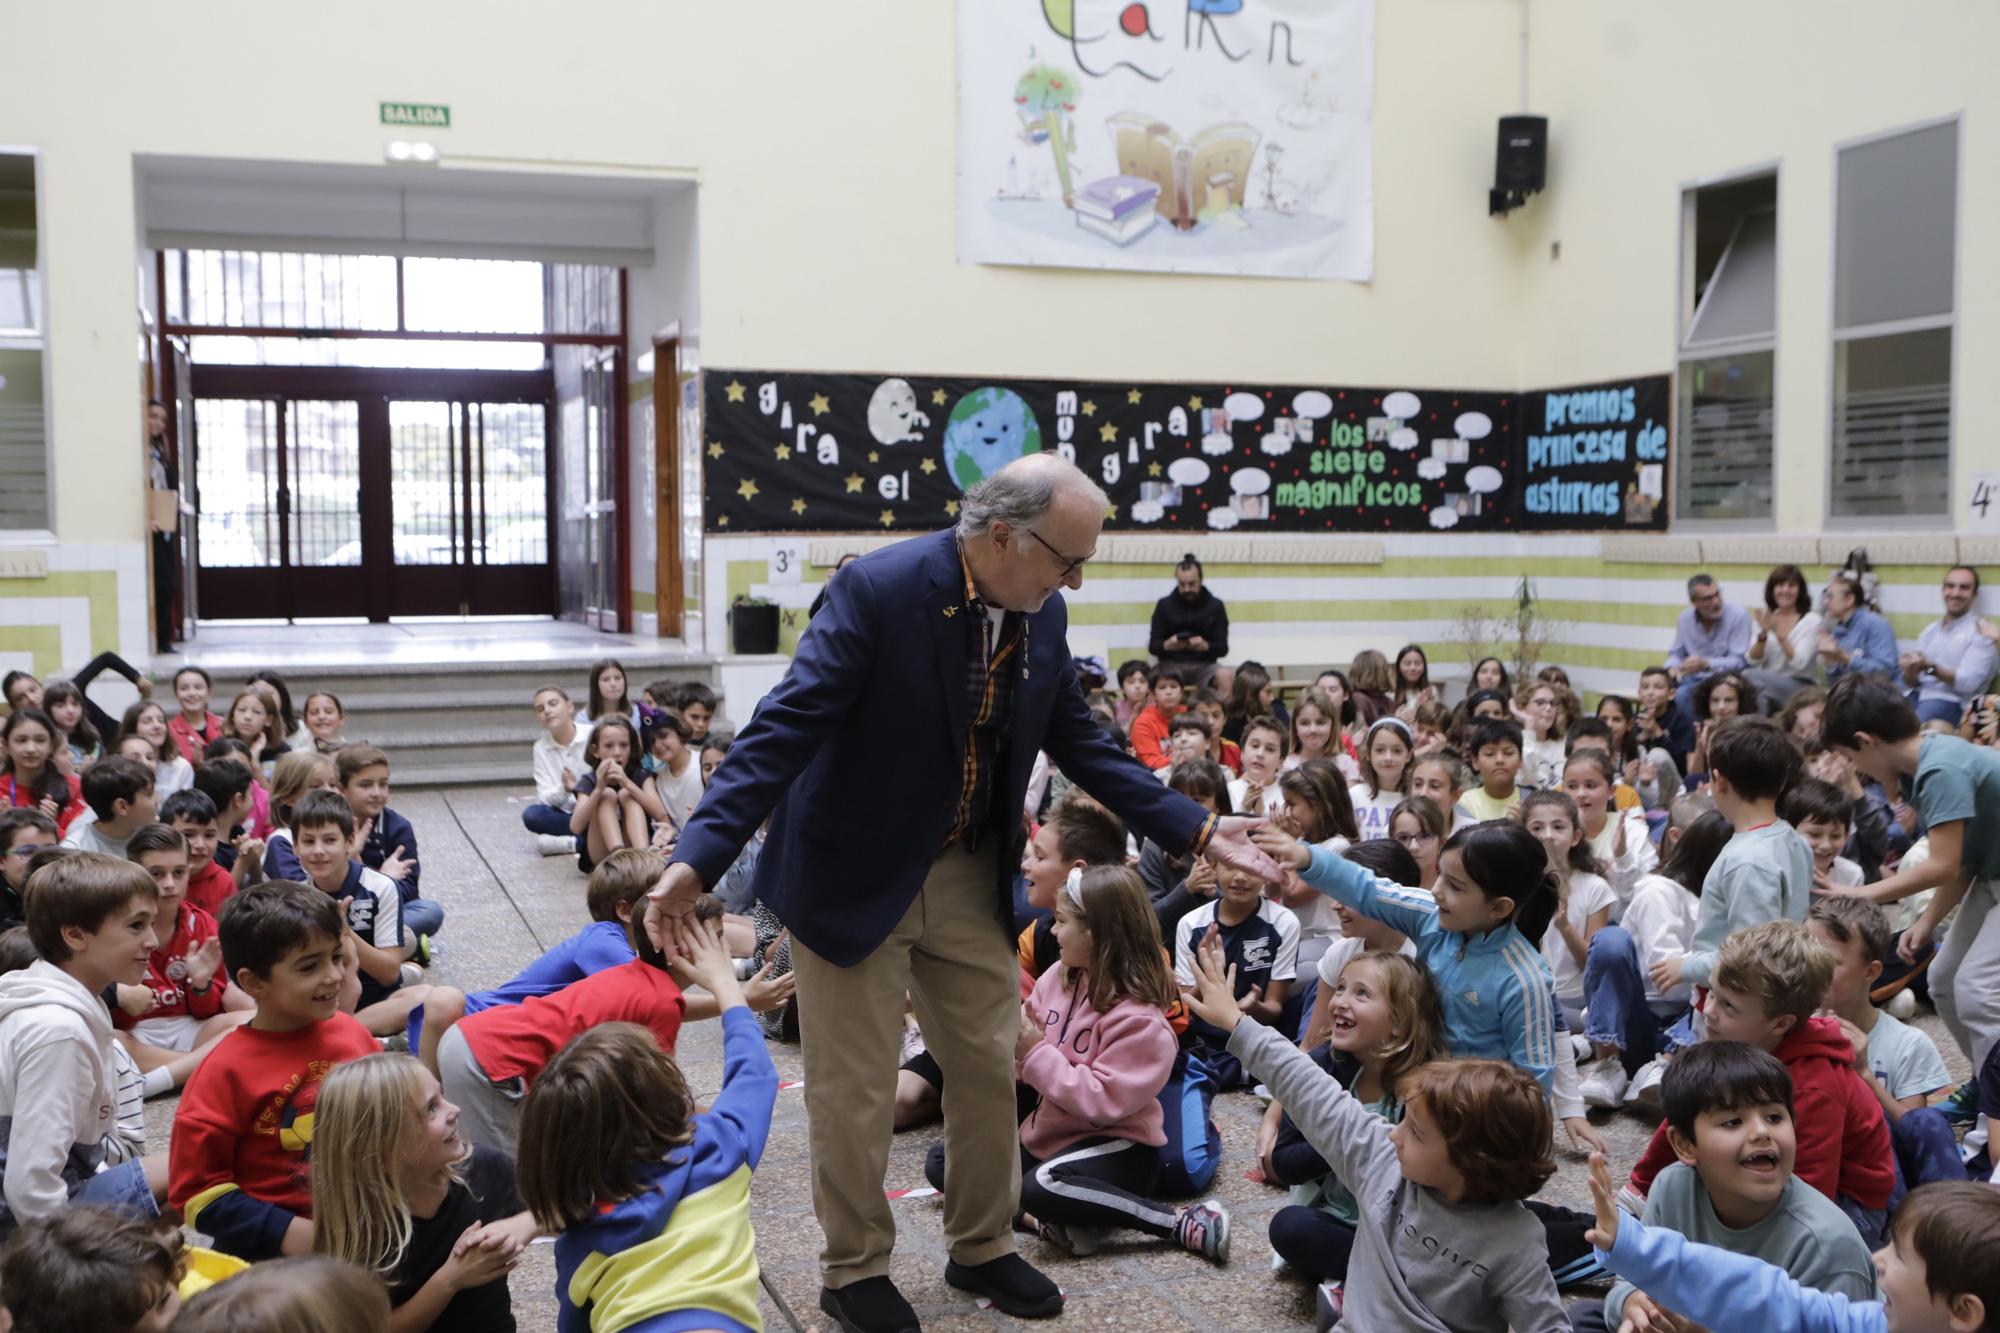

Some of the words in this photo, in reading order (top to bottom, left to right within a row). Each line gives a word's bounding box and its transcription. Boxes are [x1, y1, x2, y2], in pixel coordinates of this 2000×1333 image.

[383, 104, 447, 126] SALIDA
[758, 381, 839, 466] gira
[1545, 384, 1636, 433] premios
[1102, 405, 1188, 484] gira
[1331, 418, 1364, 448] los
[1527, 428, 1627, 473] princesa
[1635, 418, 1667, 460] de
[1309, 449, 1386, 474] siete
[878, 470, 909, 501] el
[1524, 475, 1620, 517] asturias
